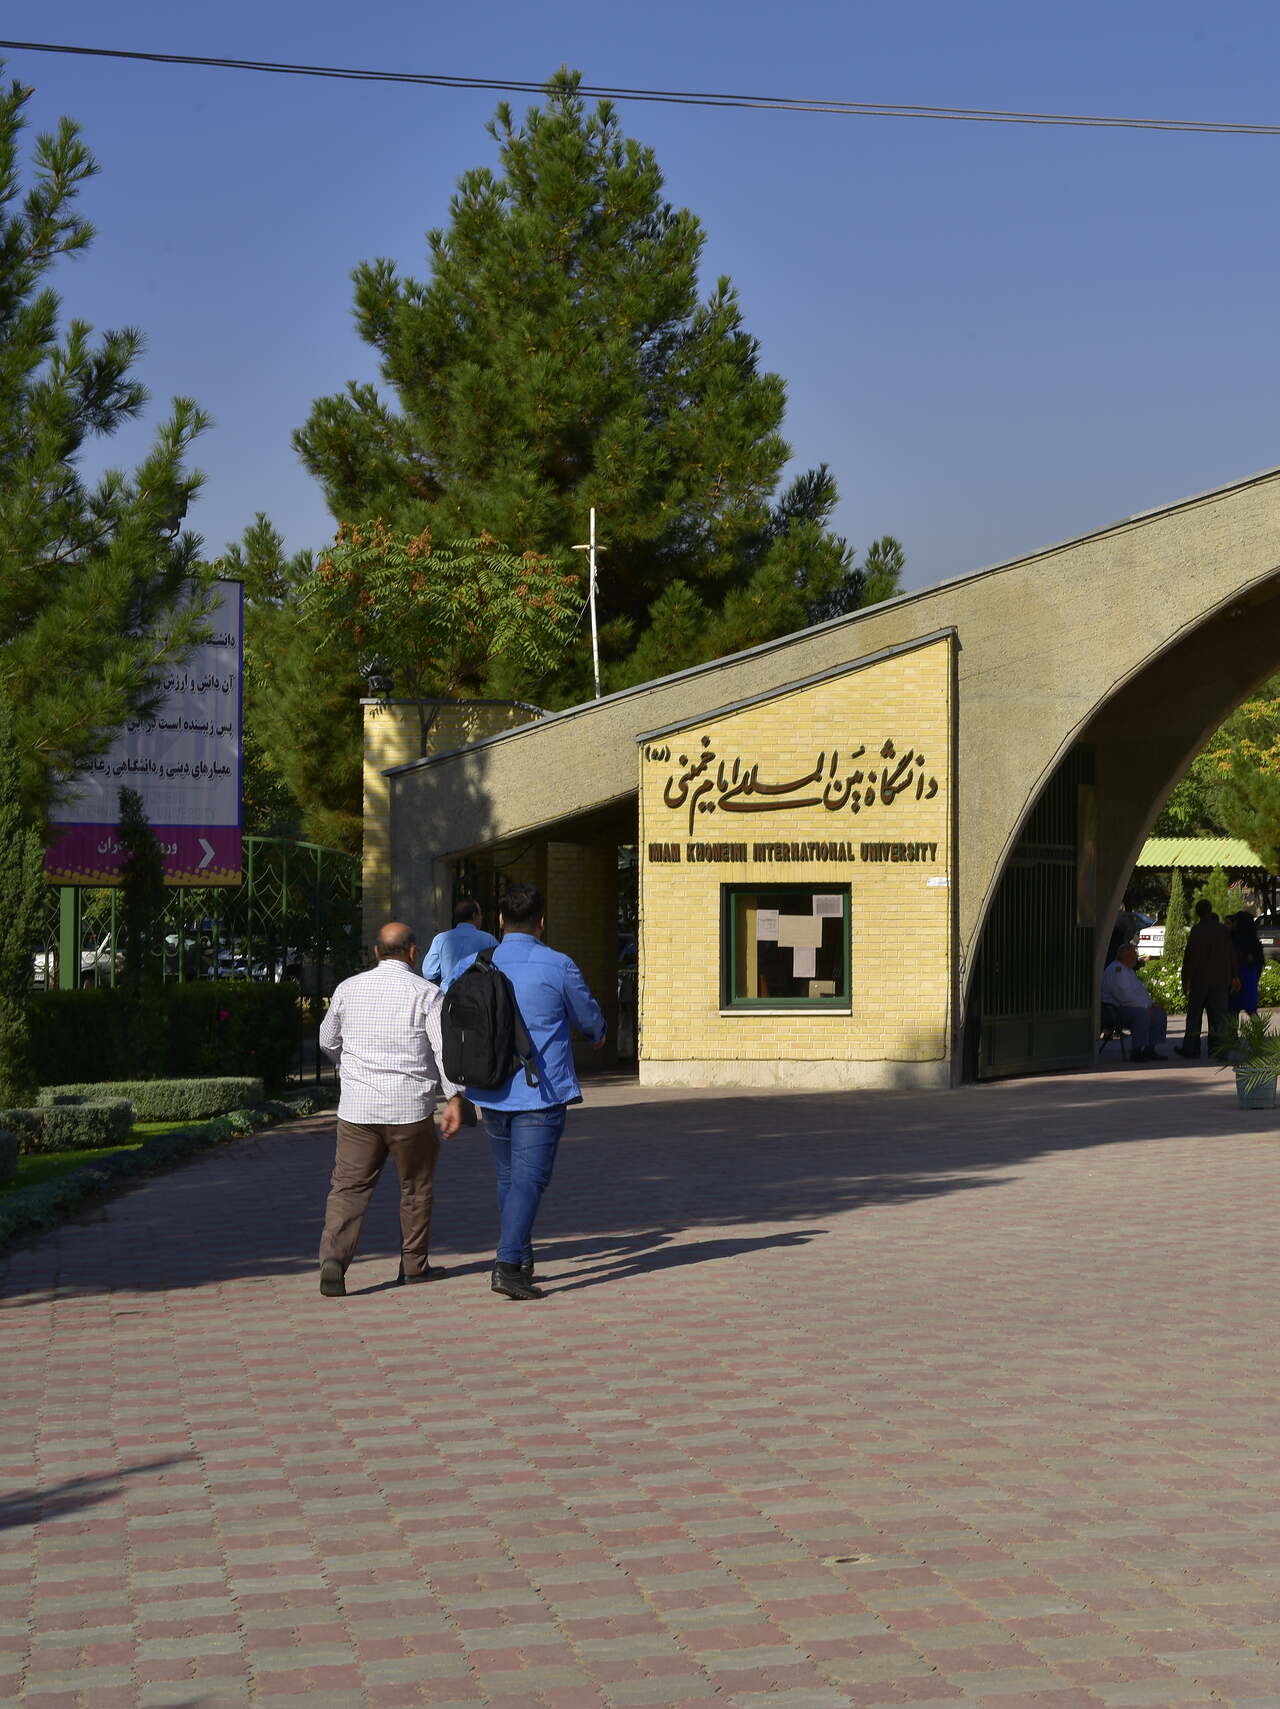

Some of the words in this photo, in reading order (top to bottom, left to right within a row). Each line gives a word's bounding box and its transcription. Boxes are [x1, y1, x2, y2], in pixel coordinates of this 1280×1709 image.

[864, 738, 939, 806] دانشگاه
[648, 842, 681, 863] IMAM
[686, 842, 748, 863] KHOMEINI
[752, 842, 855, 863] INTERNATIONAL
[860, 842, 938, 863] UNIVERSITY
